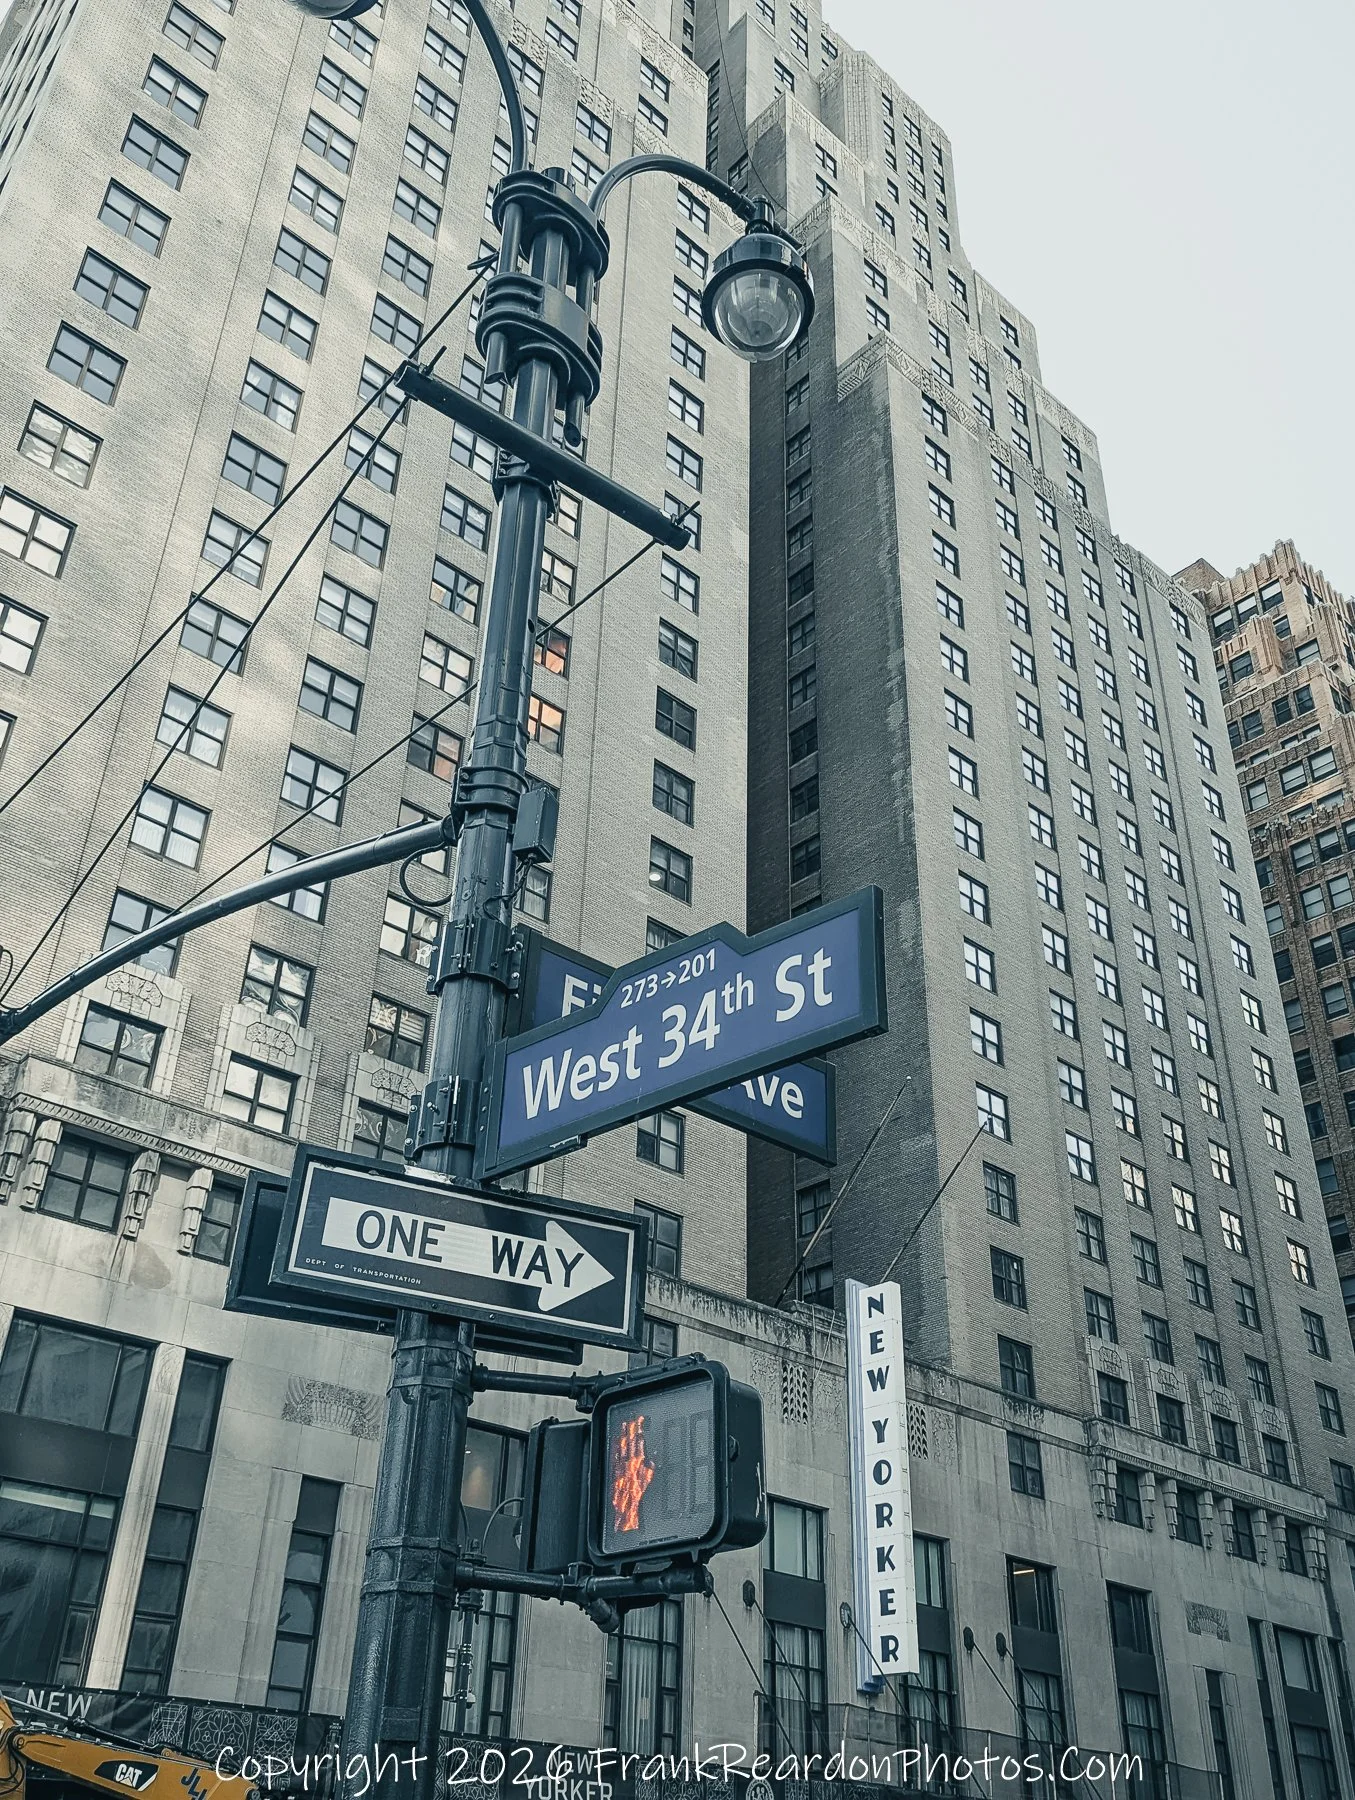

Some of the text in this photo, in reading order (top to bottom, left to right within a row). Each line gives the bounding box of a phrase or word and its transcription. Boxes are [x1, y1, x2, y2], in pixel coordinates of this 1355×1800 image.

[620, 973, 658, 1009] 273
[678, 948, 716, 985] 201
[523, 1024, 643, 1120] West
[658, 971, 754, 1069] 34th
[775, 947, 833, 1022] St
[305, 1257, 327, 1266] DEPT
[352, 1266, 422, 1285] TRANSPORTATION
[355, 1209, 585, 1288] ONE WAY
[866, 1292, 899, 1663] NEW YORKER
[26, 1688, 93, 1718] NEW
[115, 1763, 143, 1789] CAT
